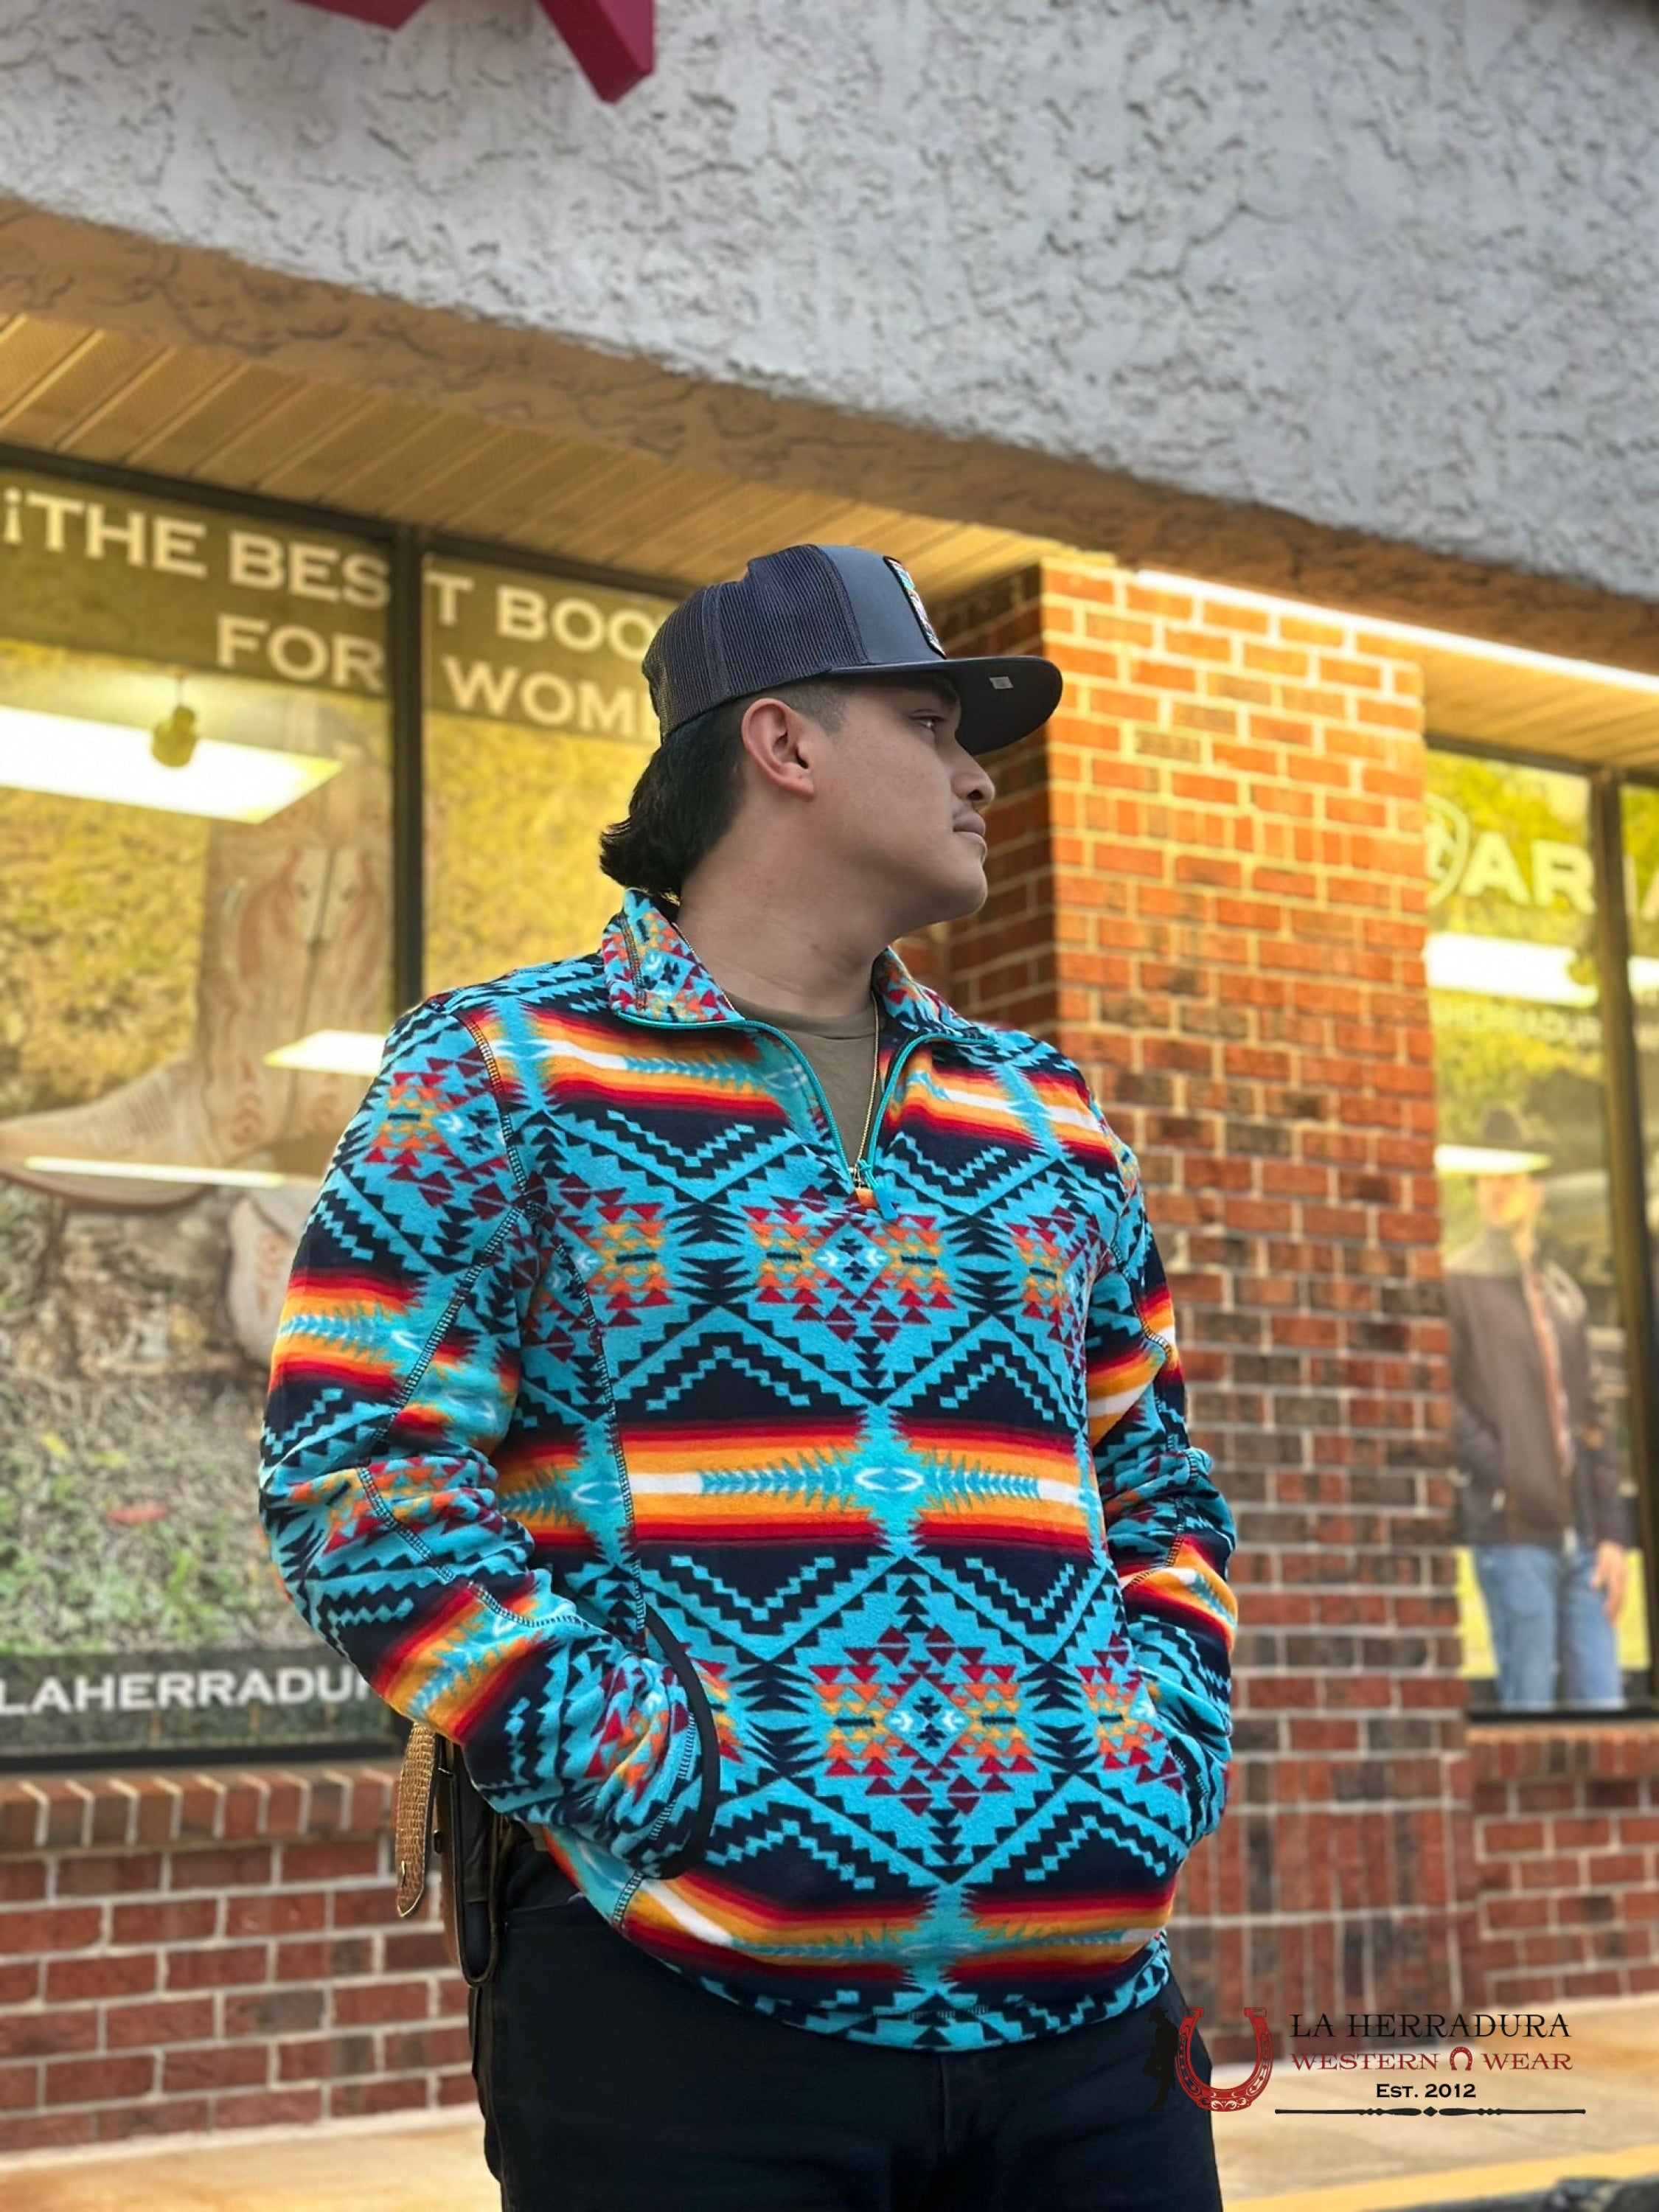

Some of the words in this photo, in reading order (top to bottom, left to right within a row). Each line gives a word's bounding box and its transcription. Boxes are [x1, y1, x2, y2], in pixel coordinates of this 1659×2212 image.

[218, 613, 386, 694] FOR
[496, 585, 667, 664] BOO
[0, 1665, 369, 1717] LAHERRADU
